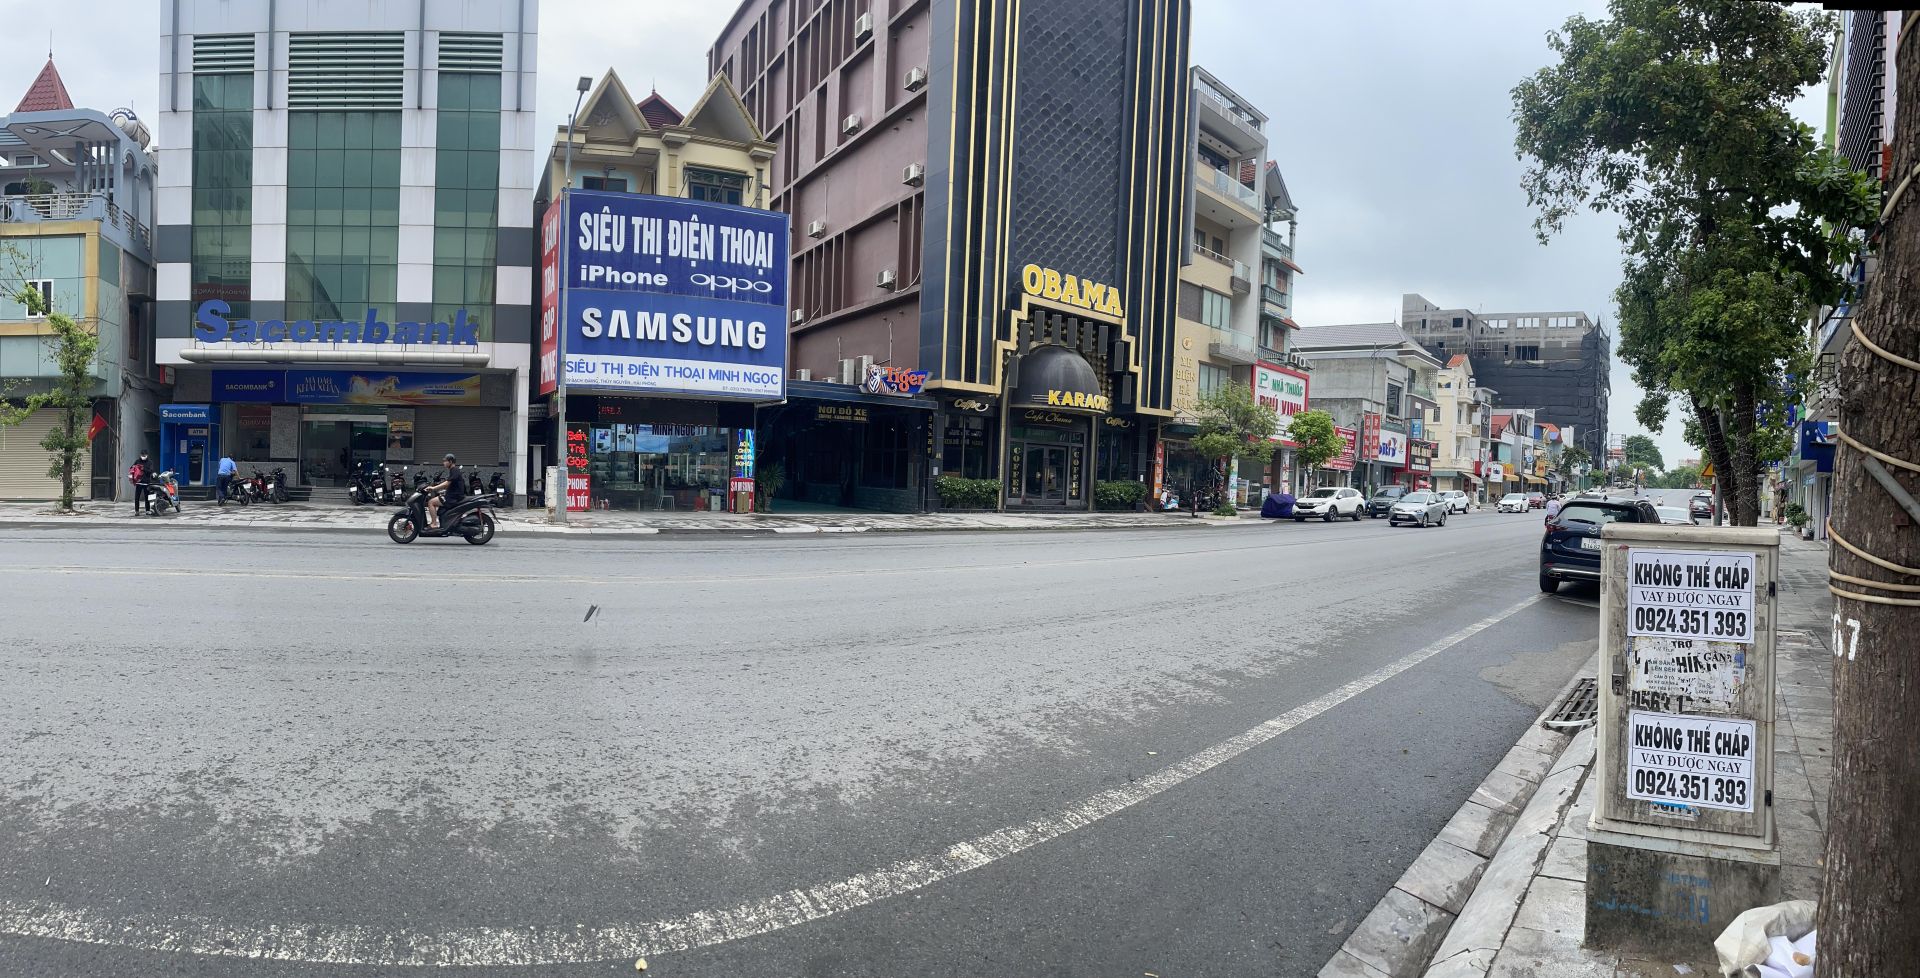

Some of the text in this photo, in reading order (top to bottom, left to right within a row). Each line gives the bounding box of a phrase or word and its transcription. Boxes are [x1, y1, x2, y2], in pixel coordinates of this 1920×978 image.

[579, 206, 774, 275] SIÊU THỊ ĐIỆN THOẠI
[580, 265, 668, 286] iPhone
[1022, 263, 1123, 317] OBAMA
[193, 299, 479, 345] Sacombank
[581, 307, 767, 350] SAMSUNG
[566, 359, 779, 388] SIÊU THỊ ĐIỆN THOẠI MINH NGỌC
[885, 366, 926, 392] Tiger
[162, 409, 207, 419] Sacombank
[1634, 558, 1750, 590] KHÔNG THẾ CHẤP
[1640, 591, 1742, 607] VAY ĐƯỢC NGAY
[1635, 606, 1747, 638] 0924.351.393
[1635, 721, 1750, 757] KHÔNG THẾ CHẤP
[1641, 752, 1742, 773] VAY ĐƯỢC NGAY
[1635, 768, 1747, 805] 0924.351.393
